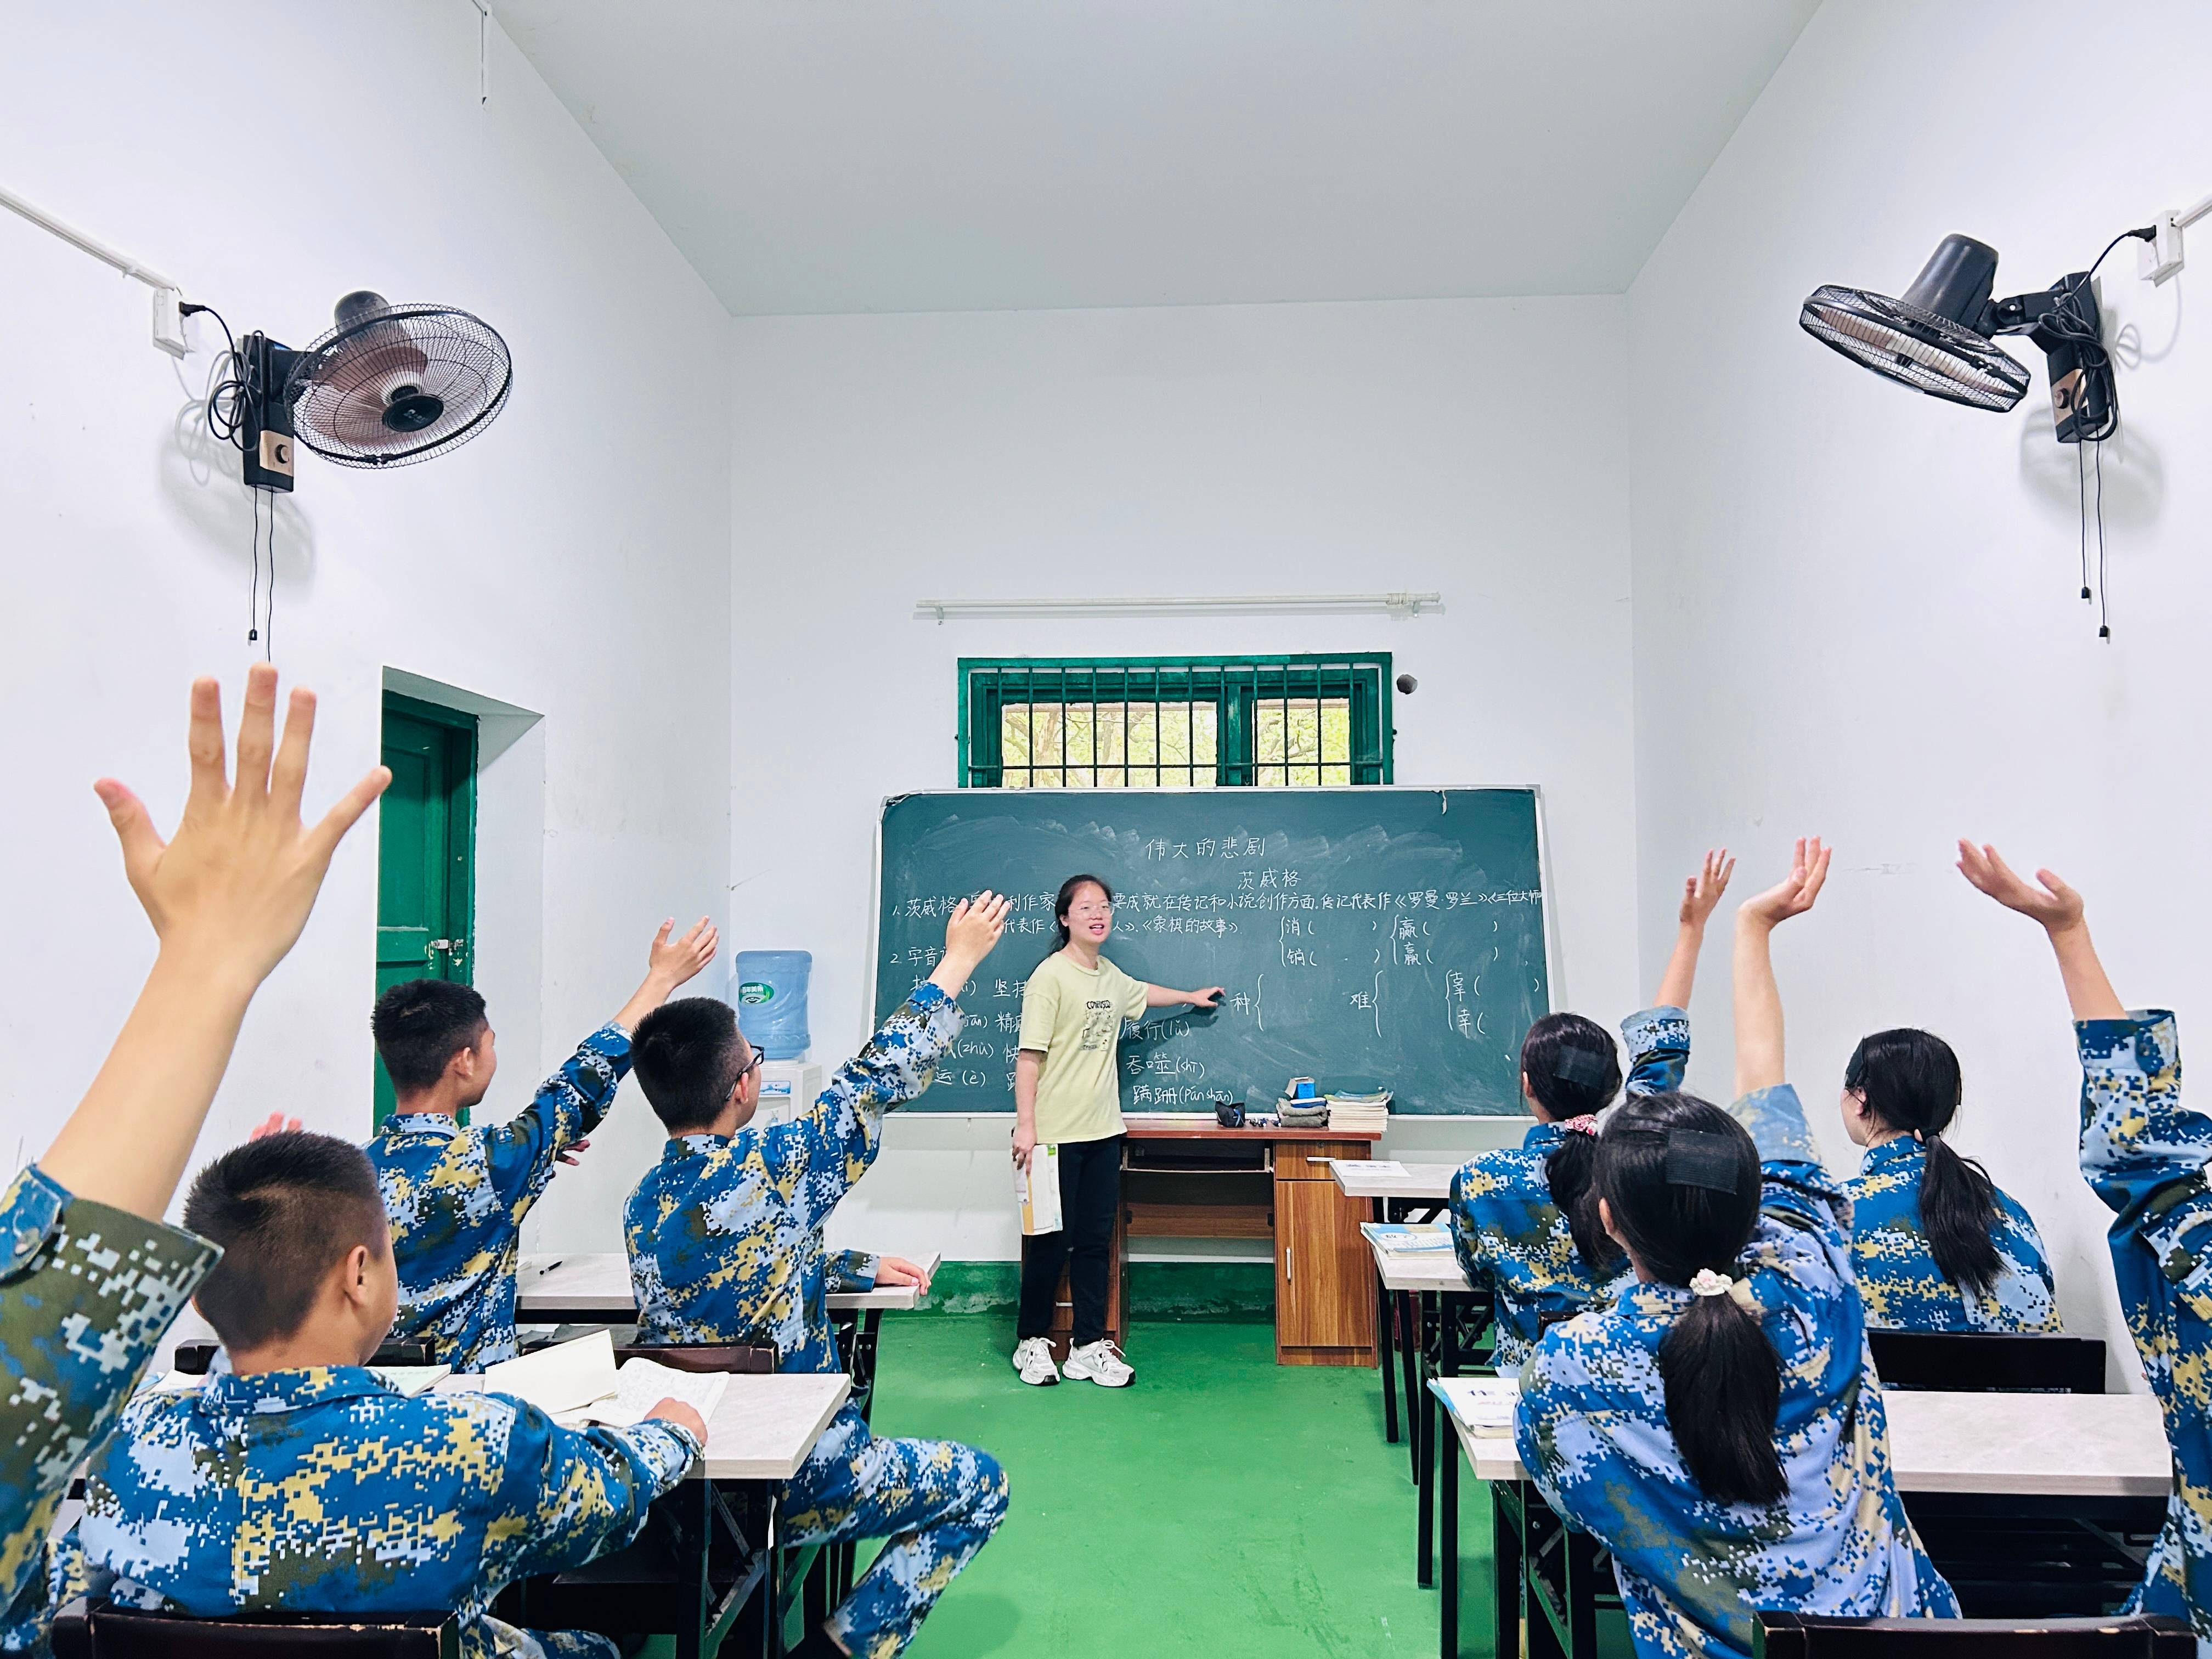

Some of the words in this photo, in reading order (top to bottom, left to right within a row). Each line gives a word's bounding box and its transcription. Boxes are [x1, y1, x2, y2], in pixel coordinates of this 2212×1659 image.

[1145, 836, 1266, 861] 伟大的悲剧
[1237, 867, 1302, 890] 茨威格
